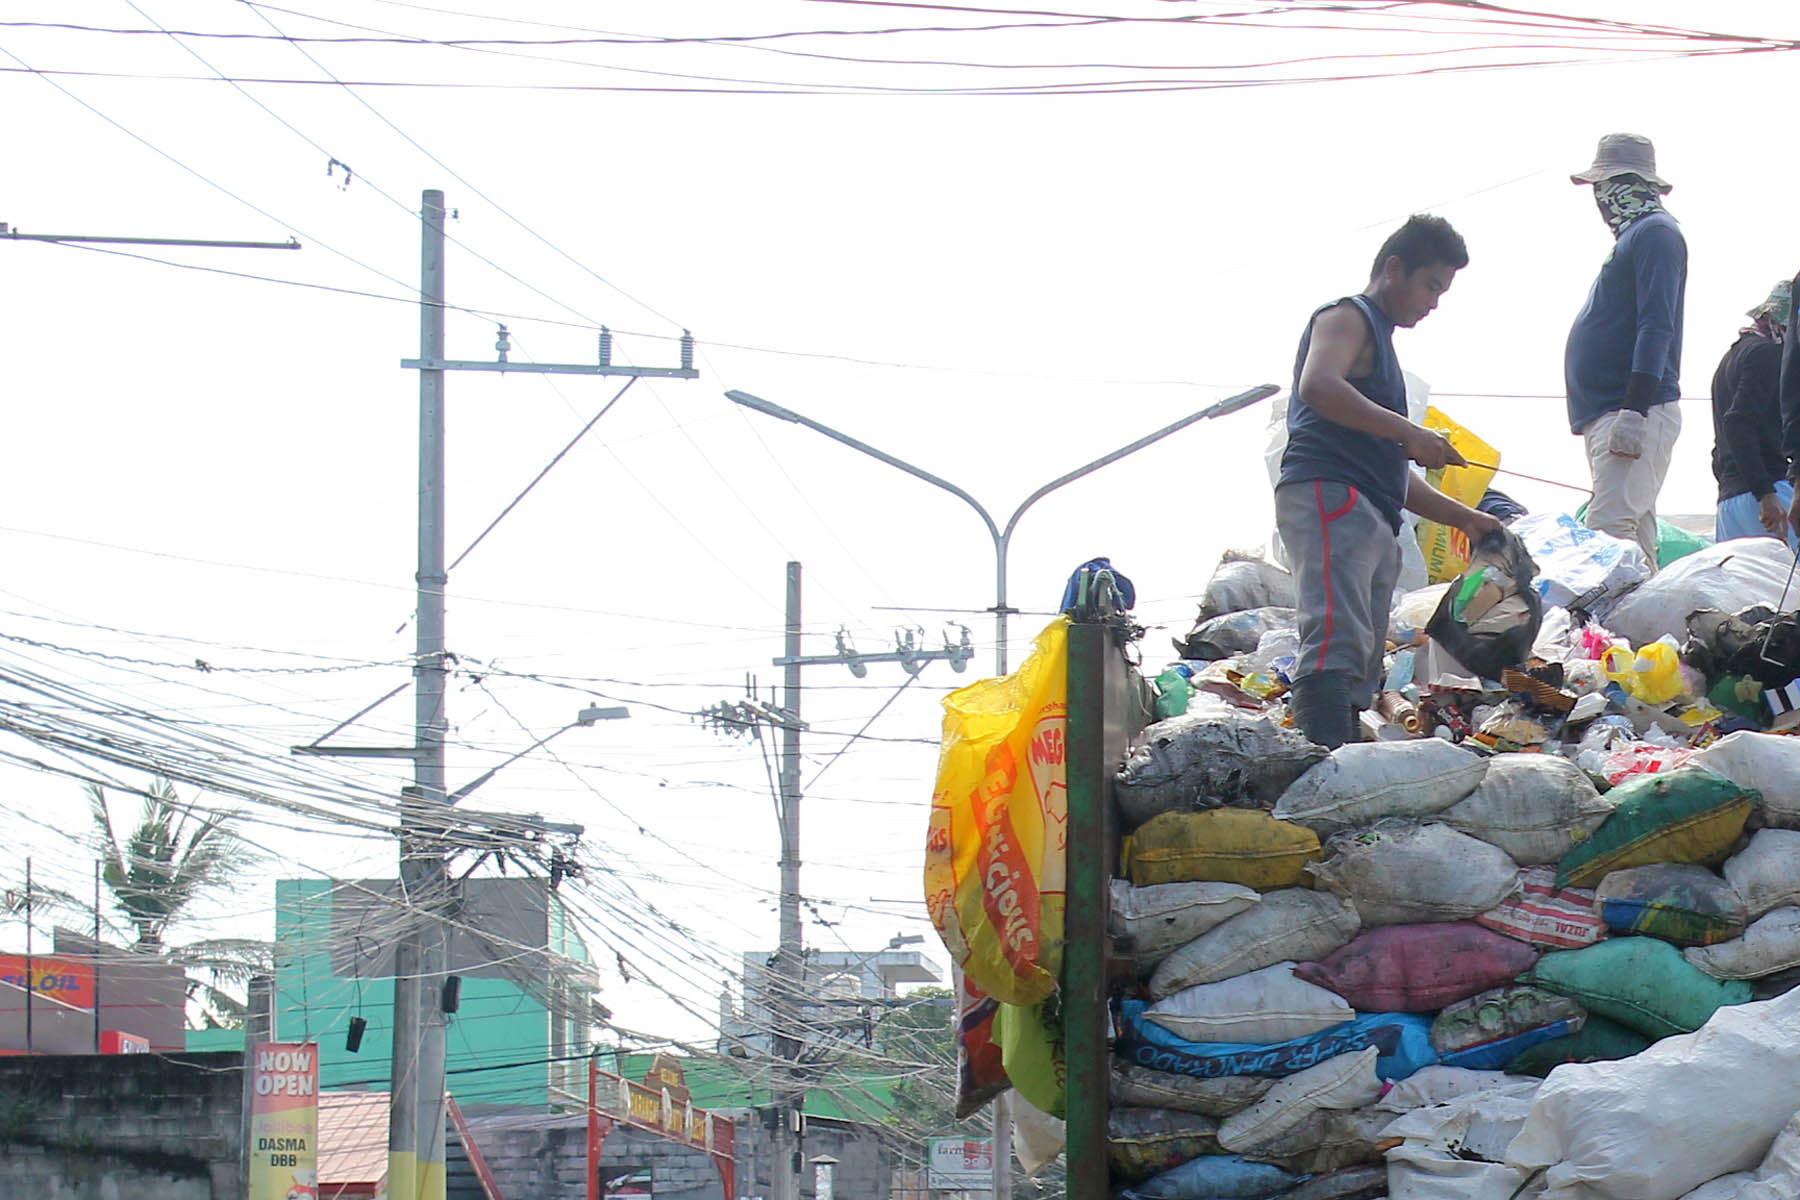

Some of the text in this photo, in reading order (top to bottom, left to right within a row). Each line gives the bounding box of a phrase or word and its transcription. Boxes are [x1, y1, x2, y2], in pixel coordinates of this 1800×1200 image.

[1032, 727, 1067, 767] MEG
[259, 1051, 312, 1073] NOW
[256, 1074, 314, 1097] OPEN
[259, 1137, 307, 1151] DASMA
[271, 1153, 298, 1168] DBB
